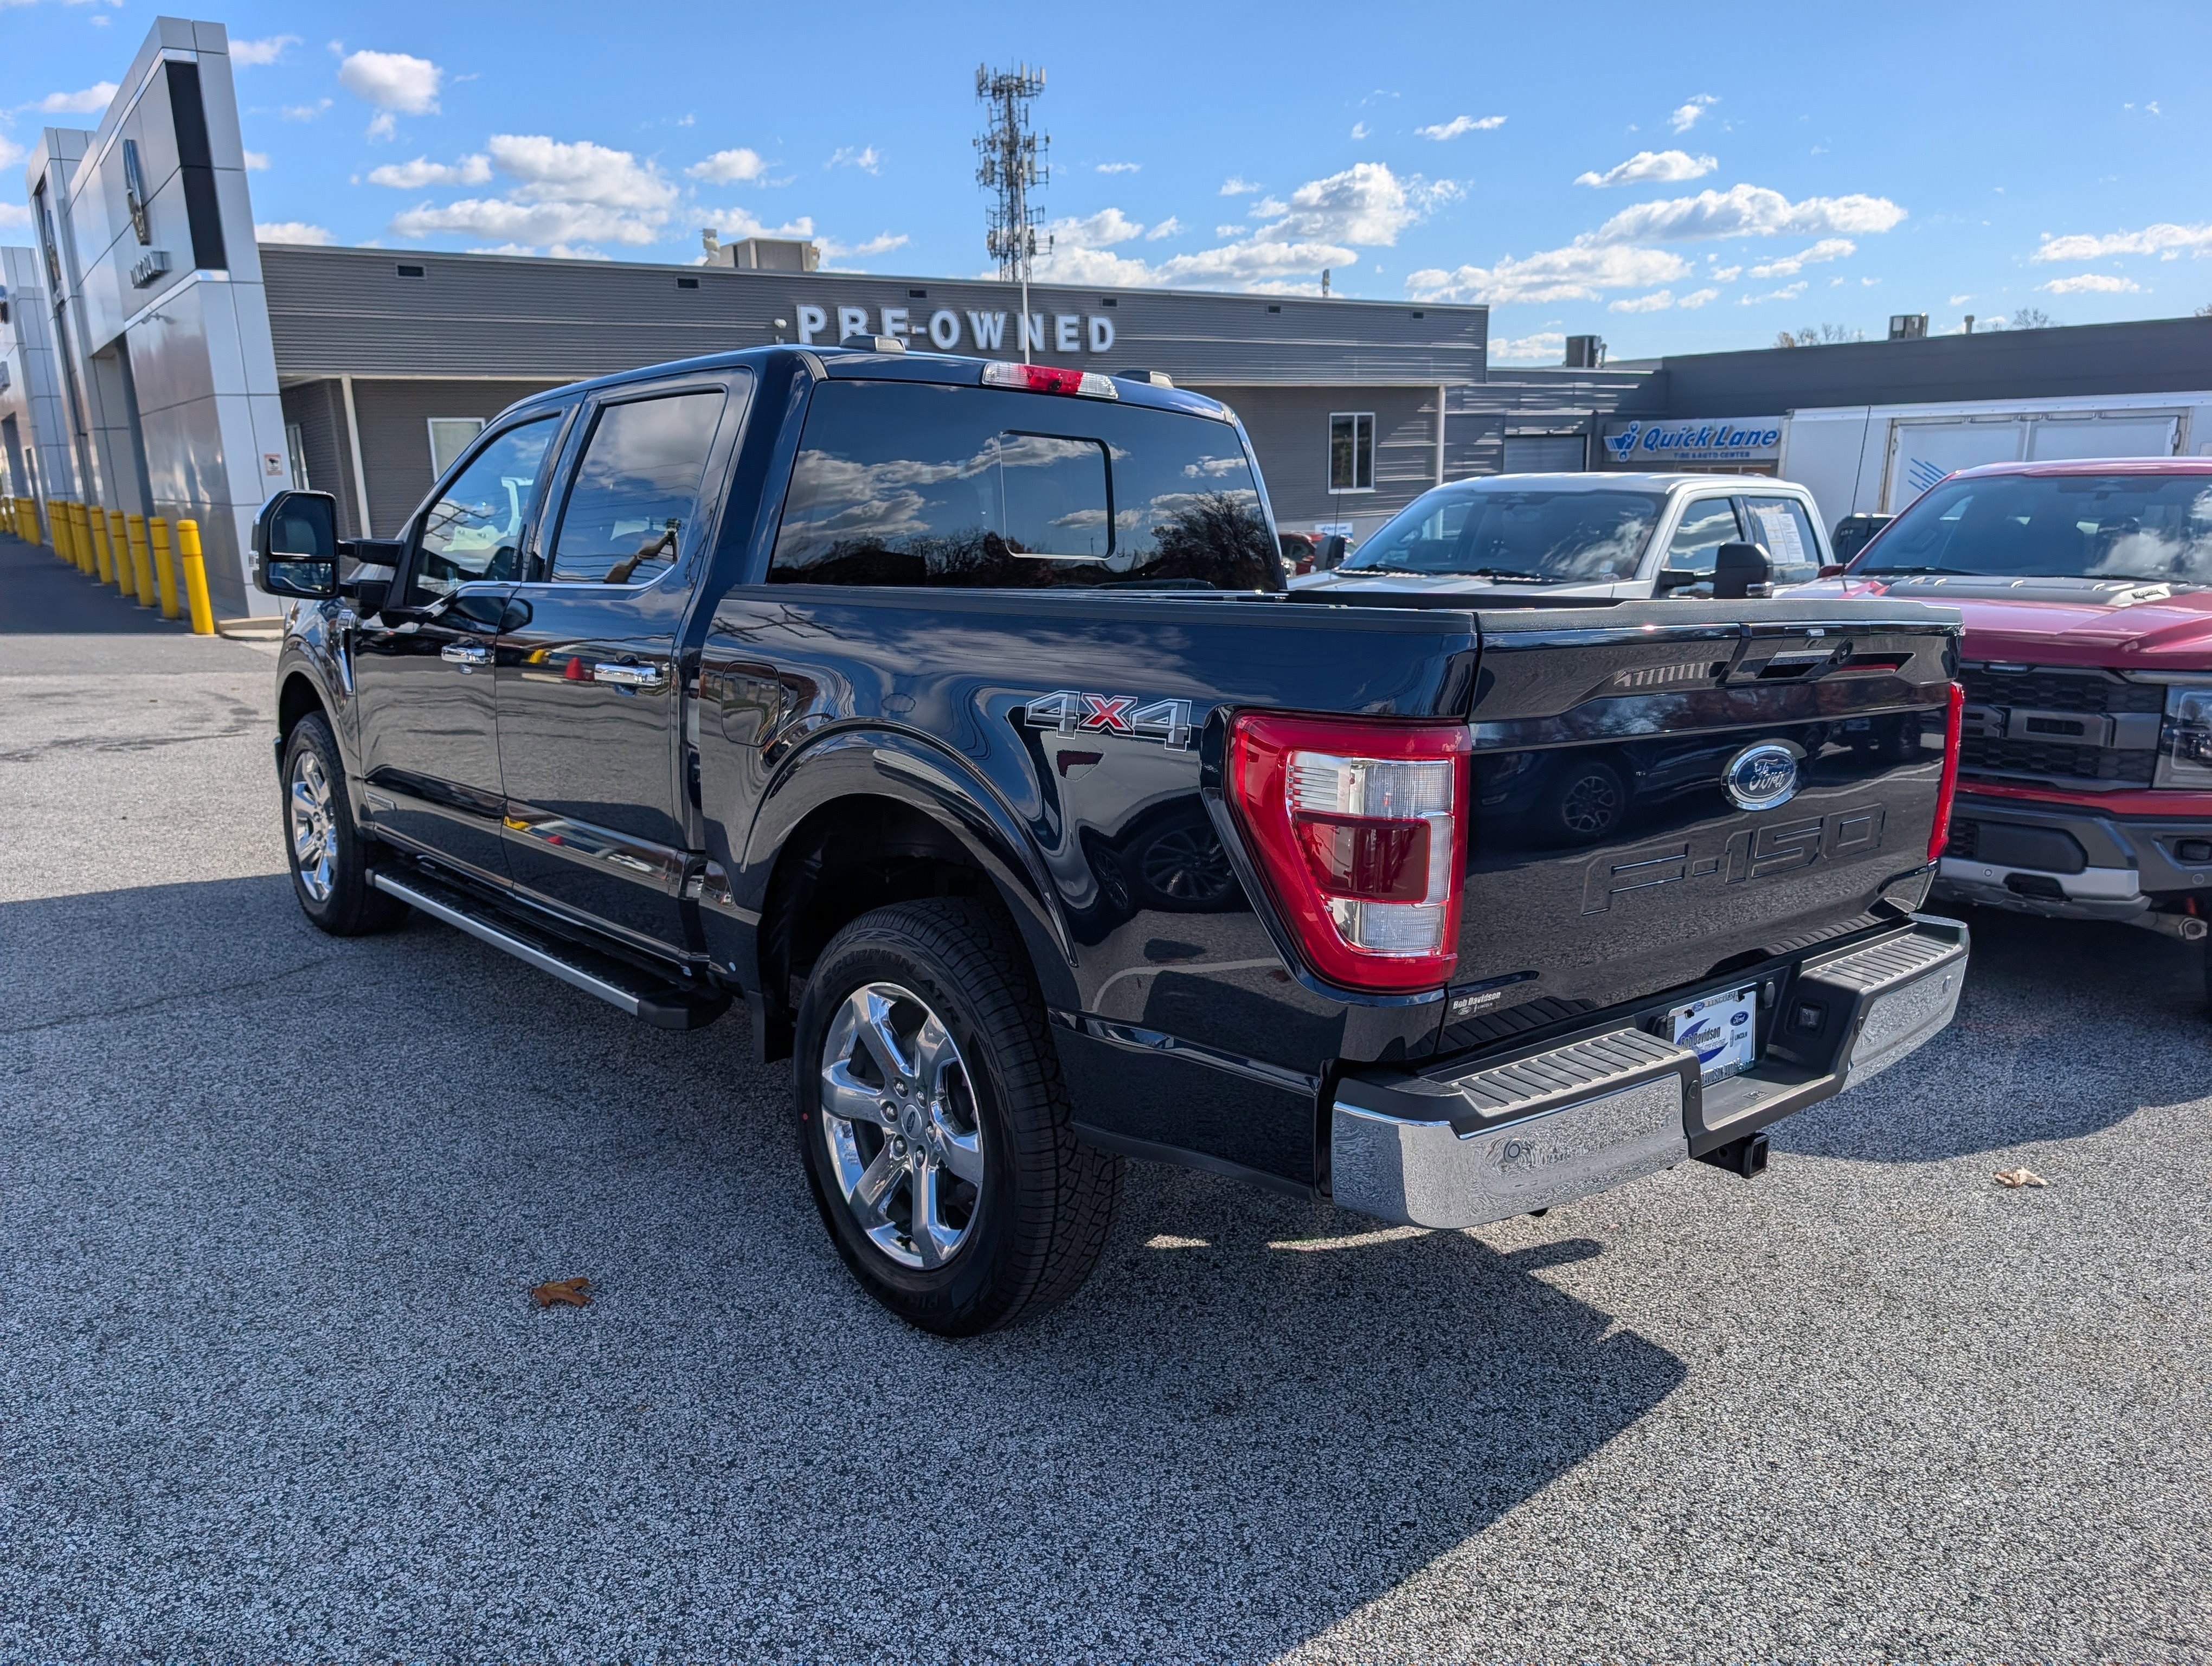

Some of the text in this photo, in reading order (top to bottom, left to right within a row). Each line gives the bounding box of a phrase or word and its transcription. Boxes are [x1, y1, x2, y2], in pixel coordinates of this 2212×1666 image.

[795, 304, 1115, 353] PRE-OWNED
[1642, 424, 1780, 452] Quick Lane
[1749, 758, 1789, 791] Ford
[1581, 803, 1886, 916] F-150
[822, 948, 917, 983] SCORPION
[1452, 992, 1501, 1010] Bob Davidson
[1732, 1013, 1747, 1024] Ford
[1681, 1034, 1694, 1048] Bob
[1694, 1026, 1721, 1046] Davidson
[1734, 1031, 1748, 1041] LINCOLN
